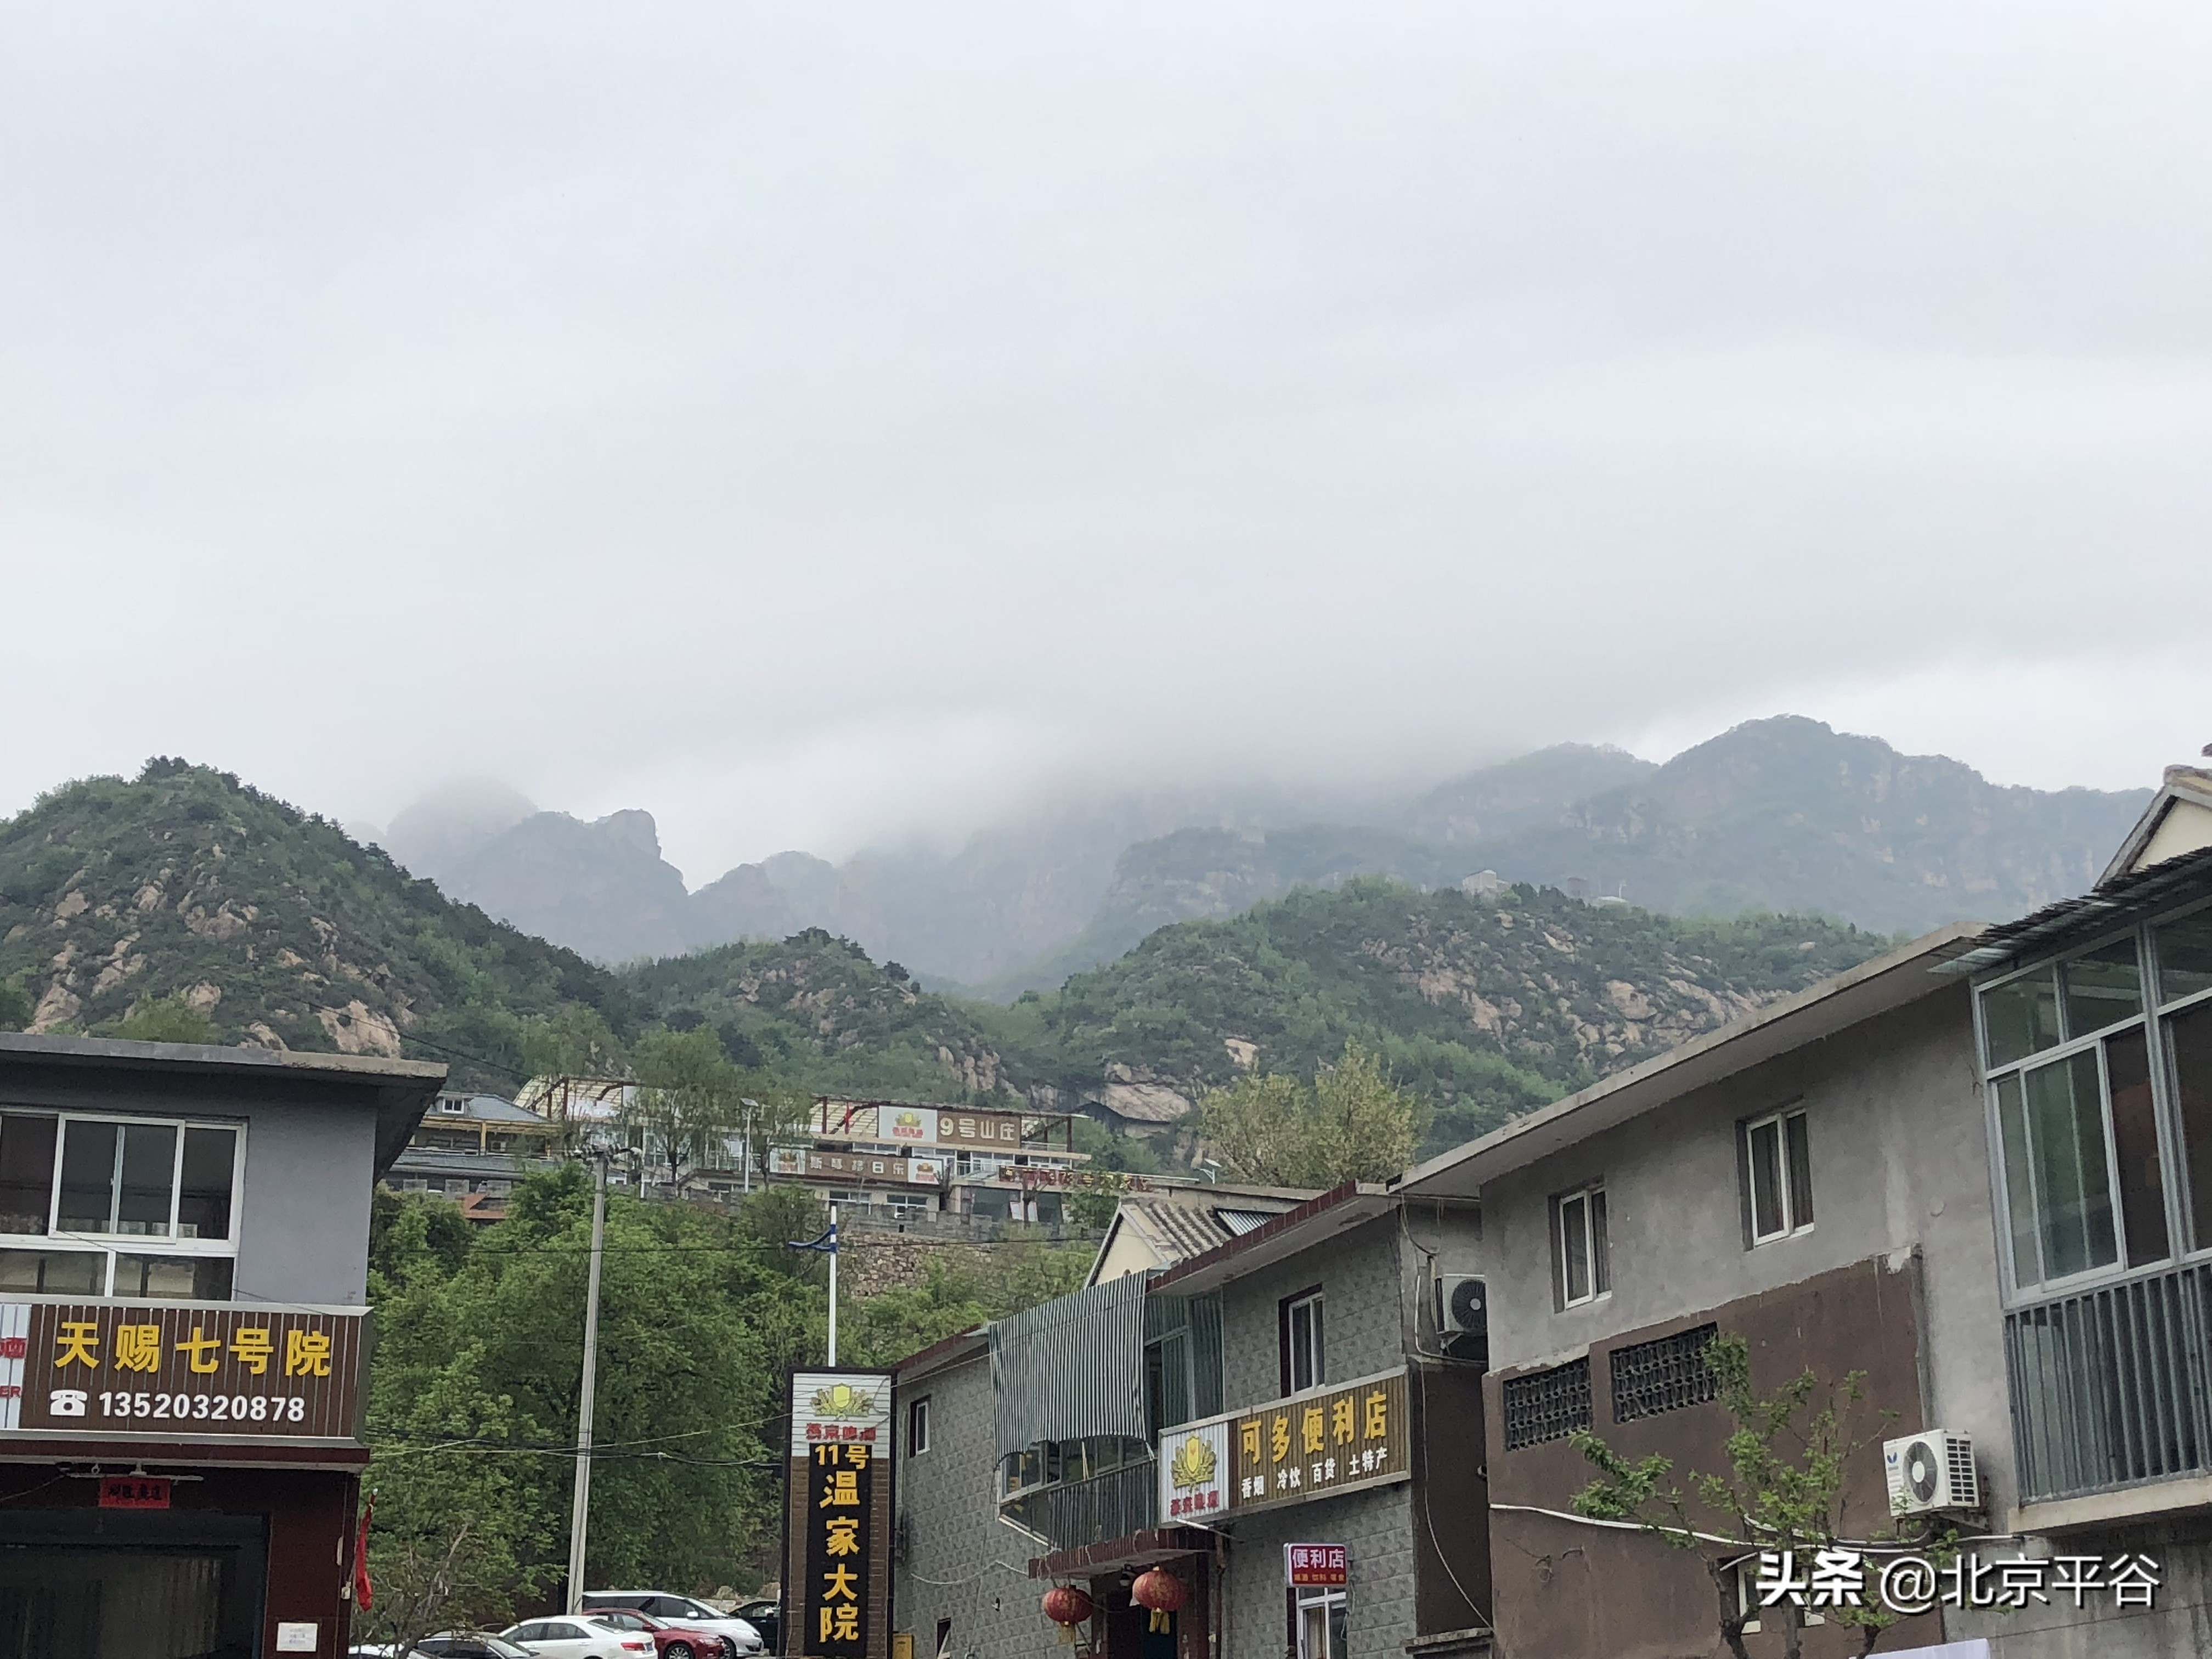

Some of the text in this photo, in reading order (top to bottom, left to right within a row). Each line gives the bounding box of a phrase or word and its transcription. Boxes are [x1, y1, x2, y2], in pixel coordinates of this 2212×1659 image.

[940, 1117, 1015, 1141] 9号山庄
[55, 1322, 330, 1376] 天赐七号院
[99, 1391, 305, 1422] 13520320878
[1241, 1391, 1387, 1464] 可多便利店
[815, 1444, 870, 1470] 11号
[1242, 1446, 1387, 1499] 香烟 冷饮 百货 土特产
[819, 1470, 861, 1644] 温家大院
[1293, 1548, 1344, 1569] 便利店
